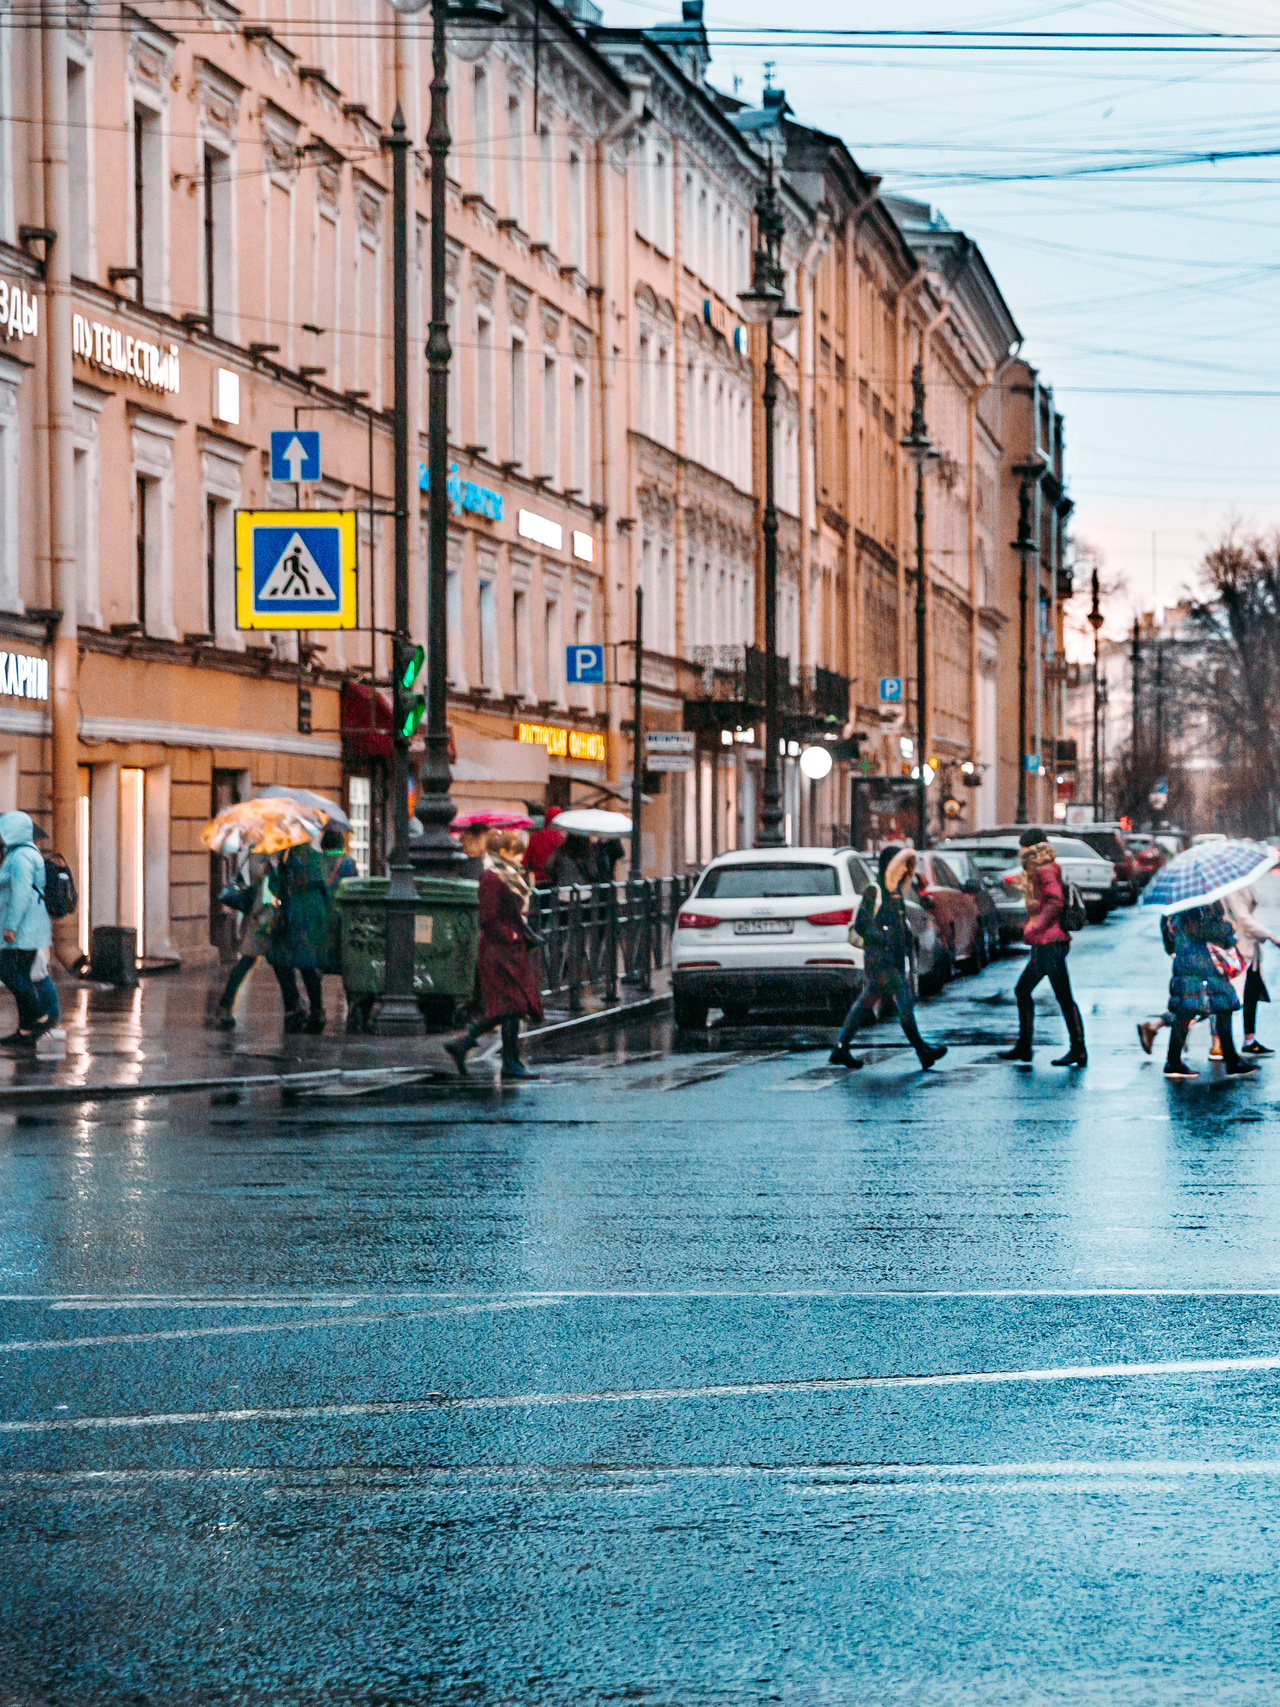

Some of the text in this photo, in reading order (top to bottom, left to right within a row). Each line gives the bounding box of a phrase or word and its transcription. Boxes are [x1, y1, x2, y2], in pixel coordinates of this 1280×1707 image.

[73, 312, 180, 394] ПУТЕШЕСТВИЙ
[576, 649, 597, 679] P
[886, 679, 899, 697] P
